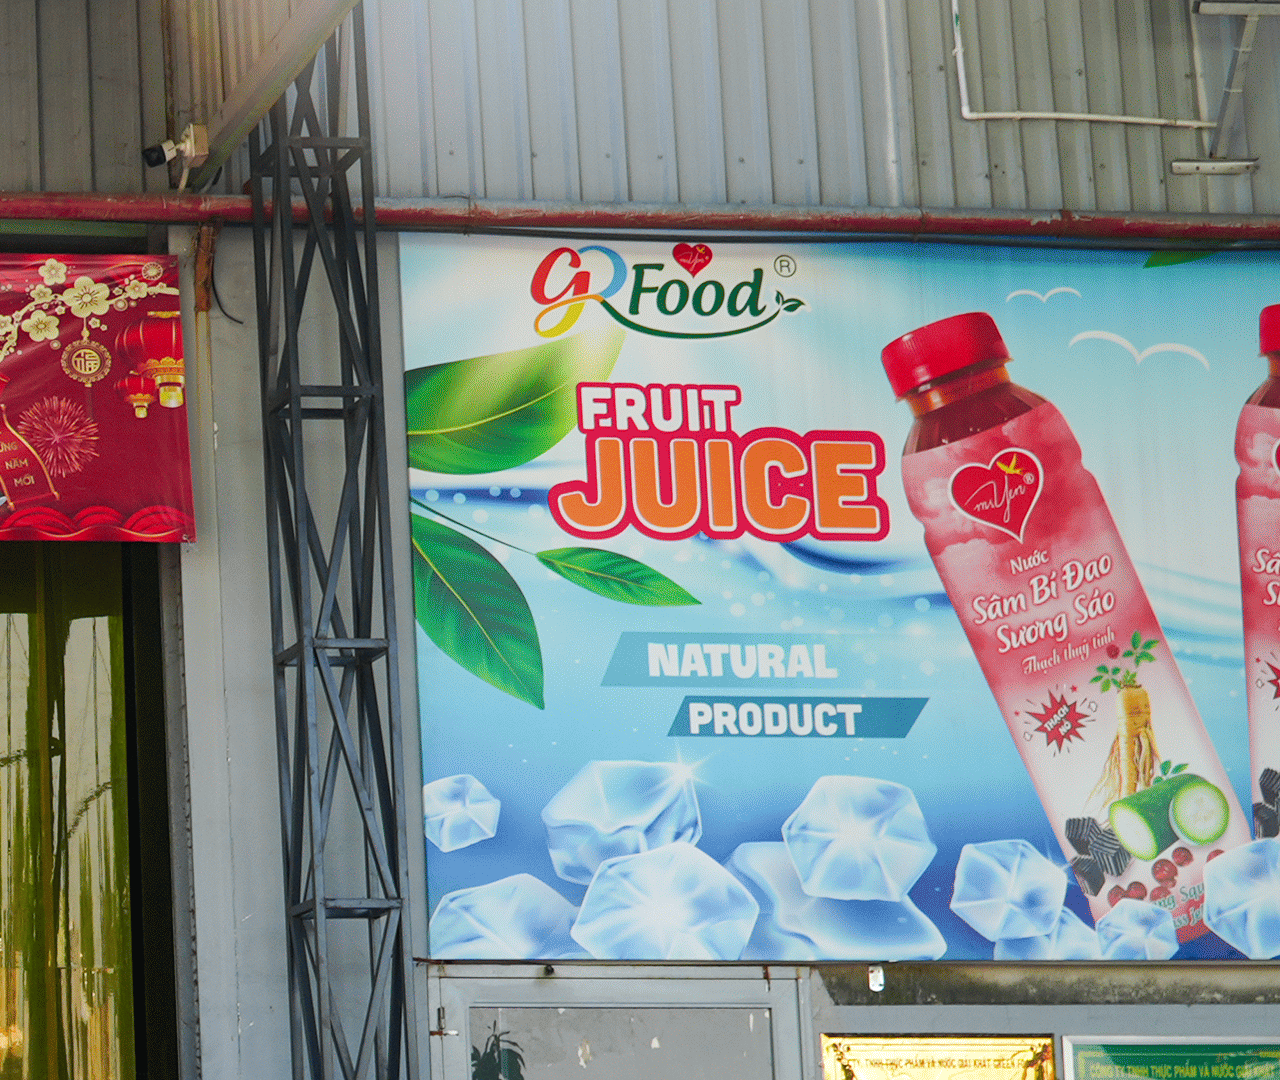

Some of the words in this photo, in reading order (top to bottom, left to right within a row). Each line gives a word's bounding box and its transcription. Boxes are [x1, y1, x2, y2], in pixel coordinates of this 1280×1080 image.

[579, 384, 740, 433] FRUIT
[555, 434, 883, 537] JUICE
[1010, 549, 1049, 575] Nước
[1252, 548, 1280, 574] Sâ
[972, 592, 1027, 625] Sâm
[1030, 570, 1060, 605] Bí
[1061, 554, 1113, 591] Đao
[996, 612, 1068, 653] Sương
[1074, 589, 1116, 624] Sáo
[646, 642, 838, 681] NATURAL
[1021, 651, 1060, 675] Thạch
[1092, 626, 1116, 649] tinh
[688, 702, 863, 737] PRODUCT
